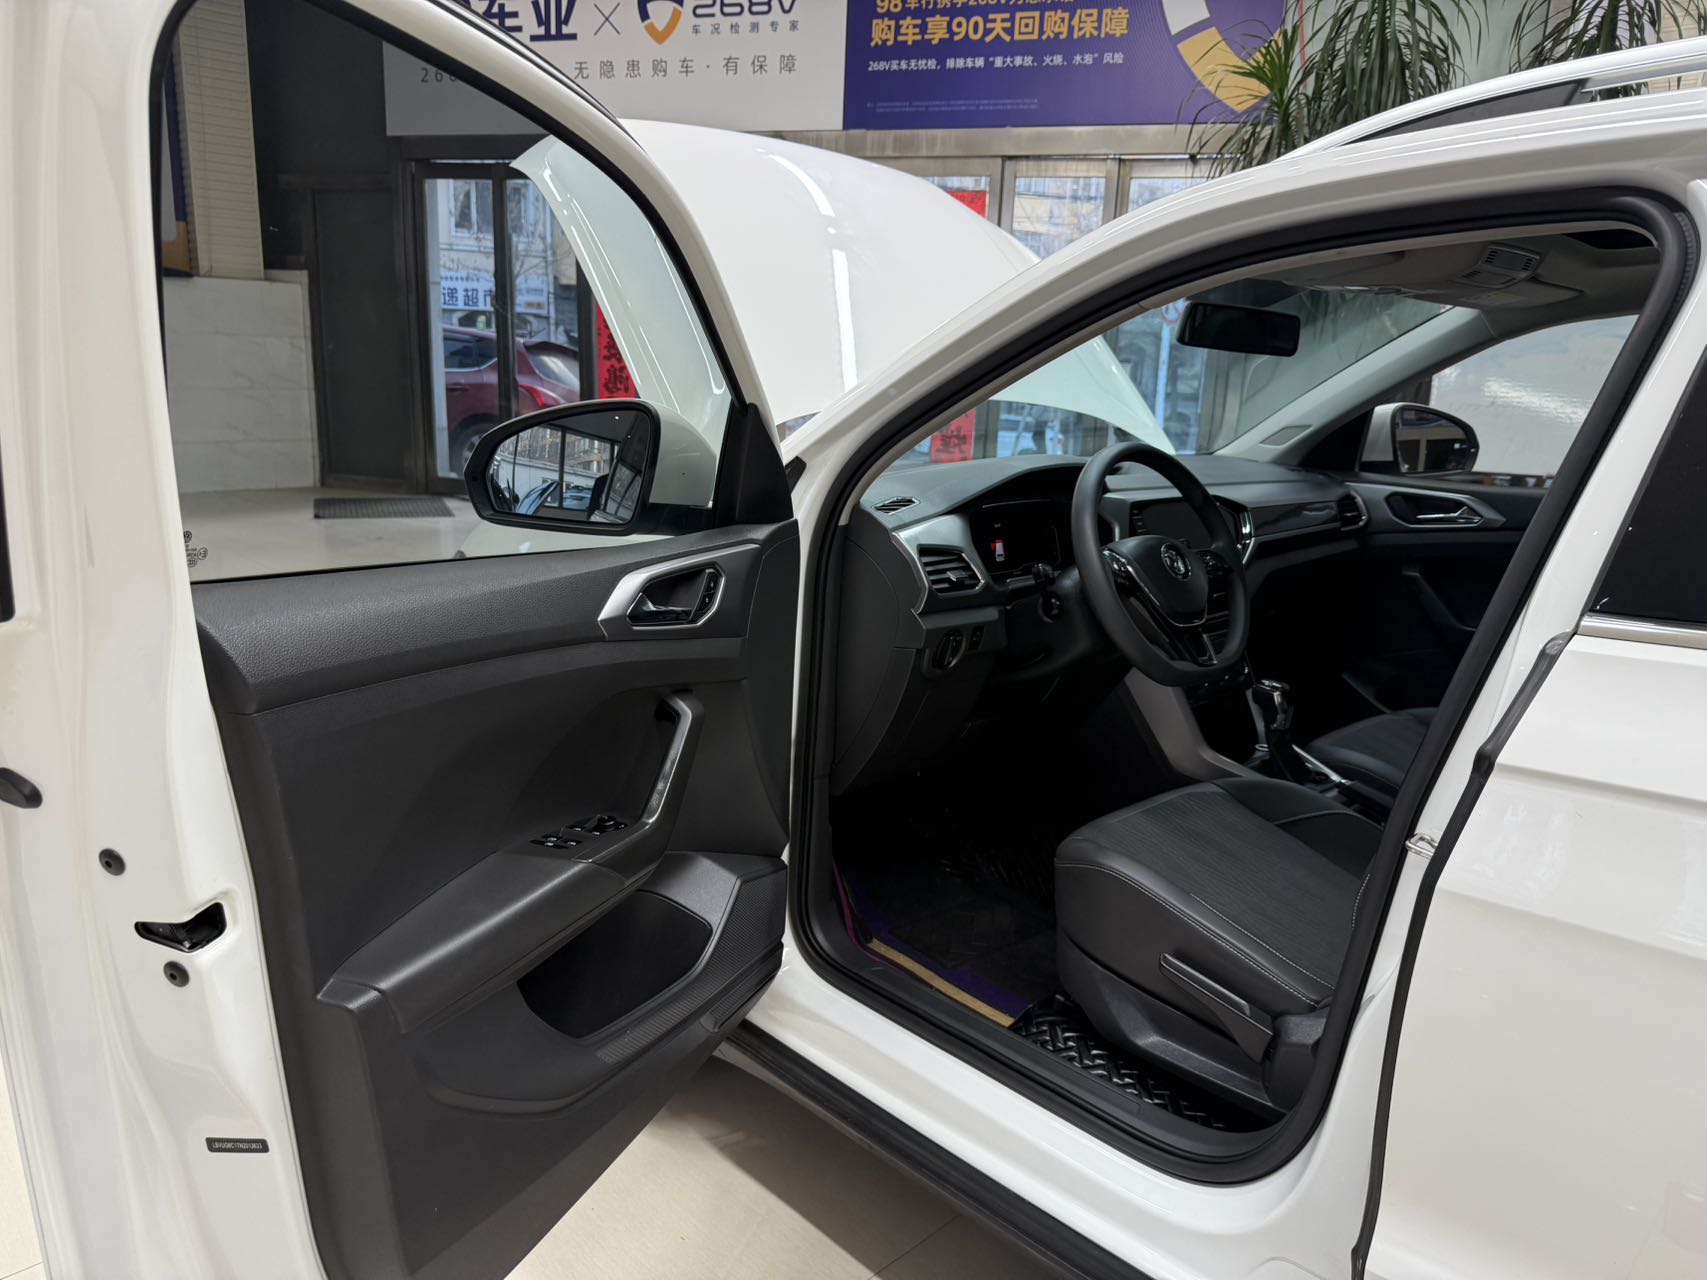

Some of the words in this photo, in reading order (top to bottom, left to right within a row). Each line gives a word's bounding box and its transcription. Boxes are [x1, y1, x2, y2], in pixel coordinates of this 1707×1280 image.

[462, 0, 578, 42] 车业
[692, 0, 796, 18] 268V
[691, 20, 800, 35] 车况检测专家
[870, 7, 1129, 47] 购车享90天回购保障
[574, 54, 797, 80] 无隐患购车·有保障
